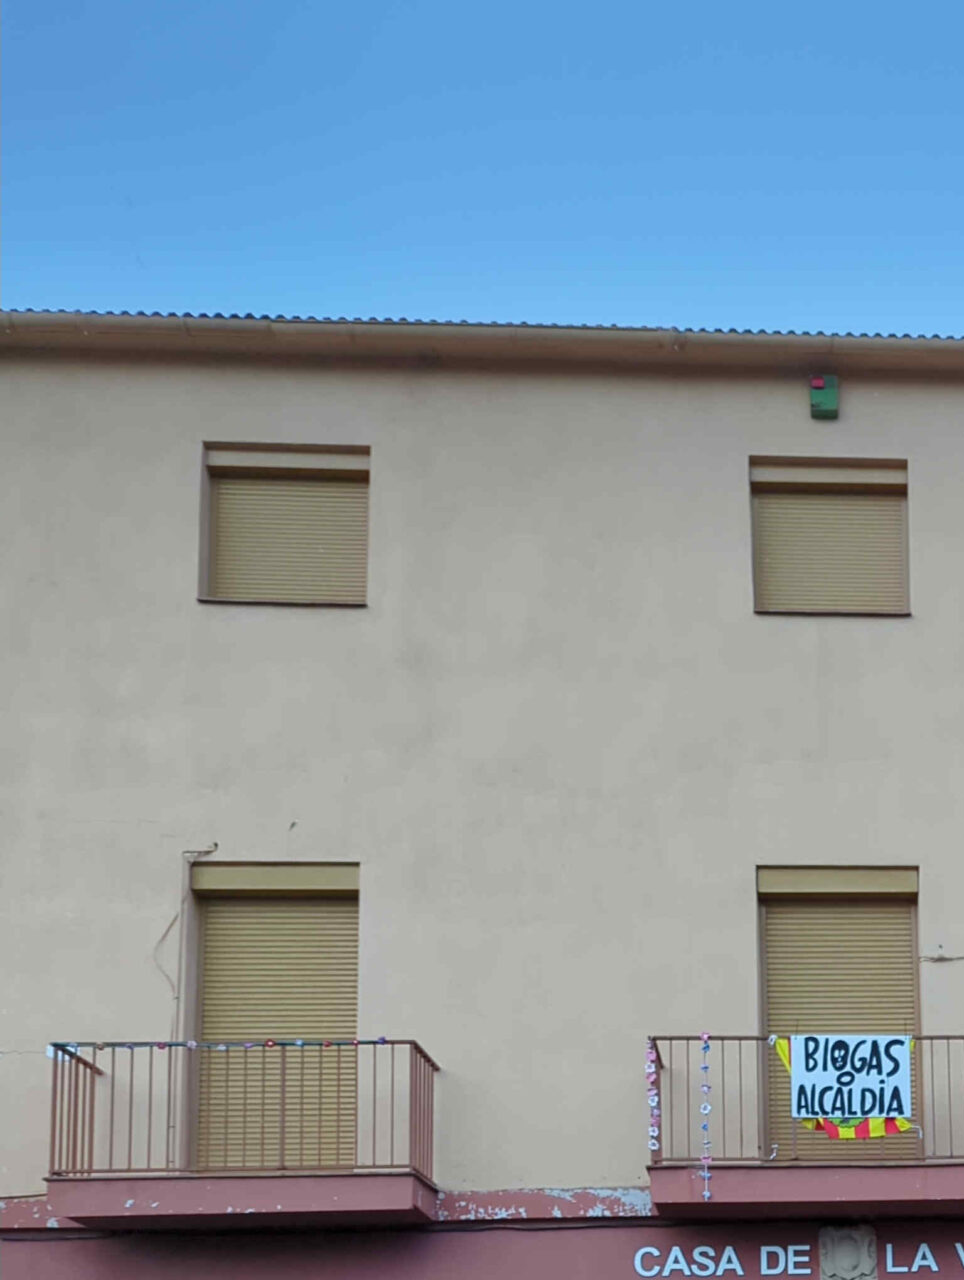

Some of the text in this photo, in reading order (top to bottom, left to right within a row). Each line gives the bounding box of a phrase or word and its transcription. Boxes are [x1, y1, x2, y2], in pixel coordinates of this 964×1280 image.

[804, 1036, 905, 1077] BIOGAS
[634, 1246, 744, 1277] CASA
[760, 1245, 811, 1275] DE
[886, 1244, 939, 1272] LA
